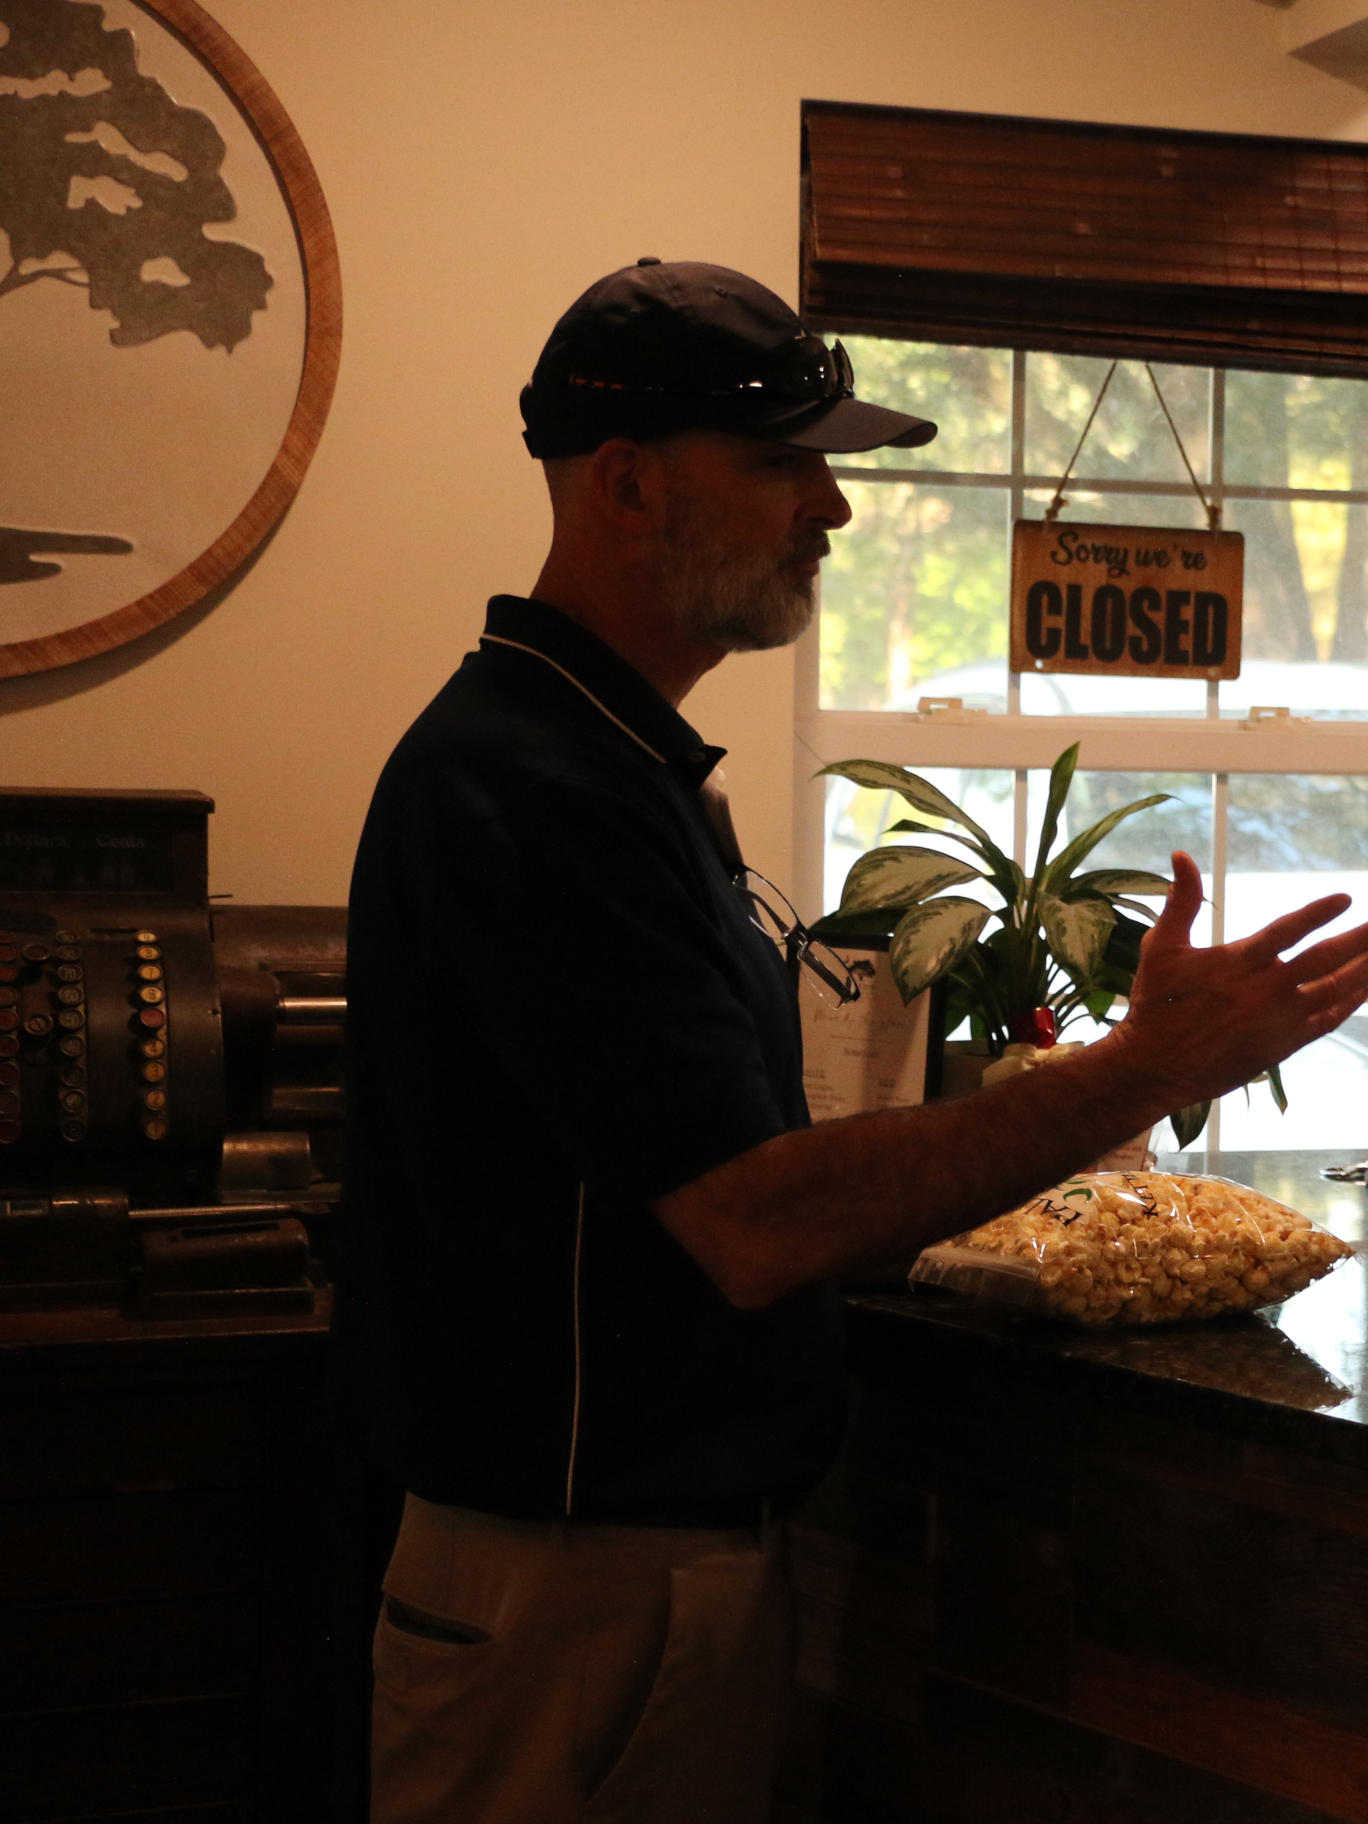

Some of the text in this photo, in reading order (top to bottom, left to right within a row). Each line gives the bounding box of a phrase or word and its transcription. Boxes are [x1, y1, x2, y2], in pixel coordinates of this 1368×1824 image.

[1051, 531, 1208, 578] Sorry we're
[1026, 580, 1228, 667] CLOSED
